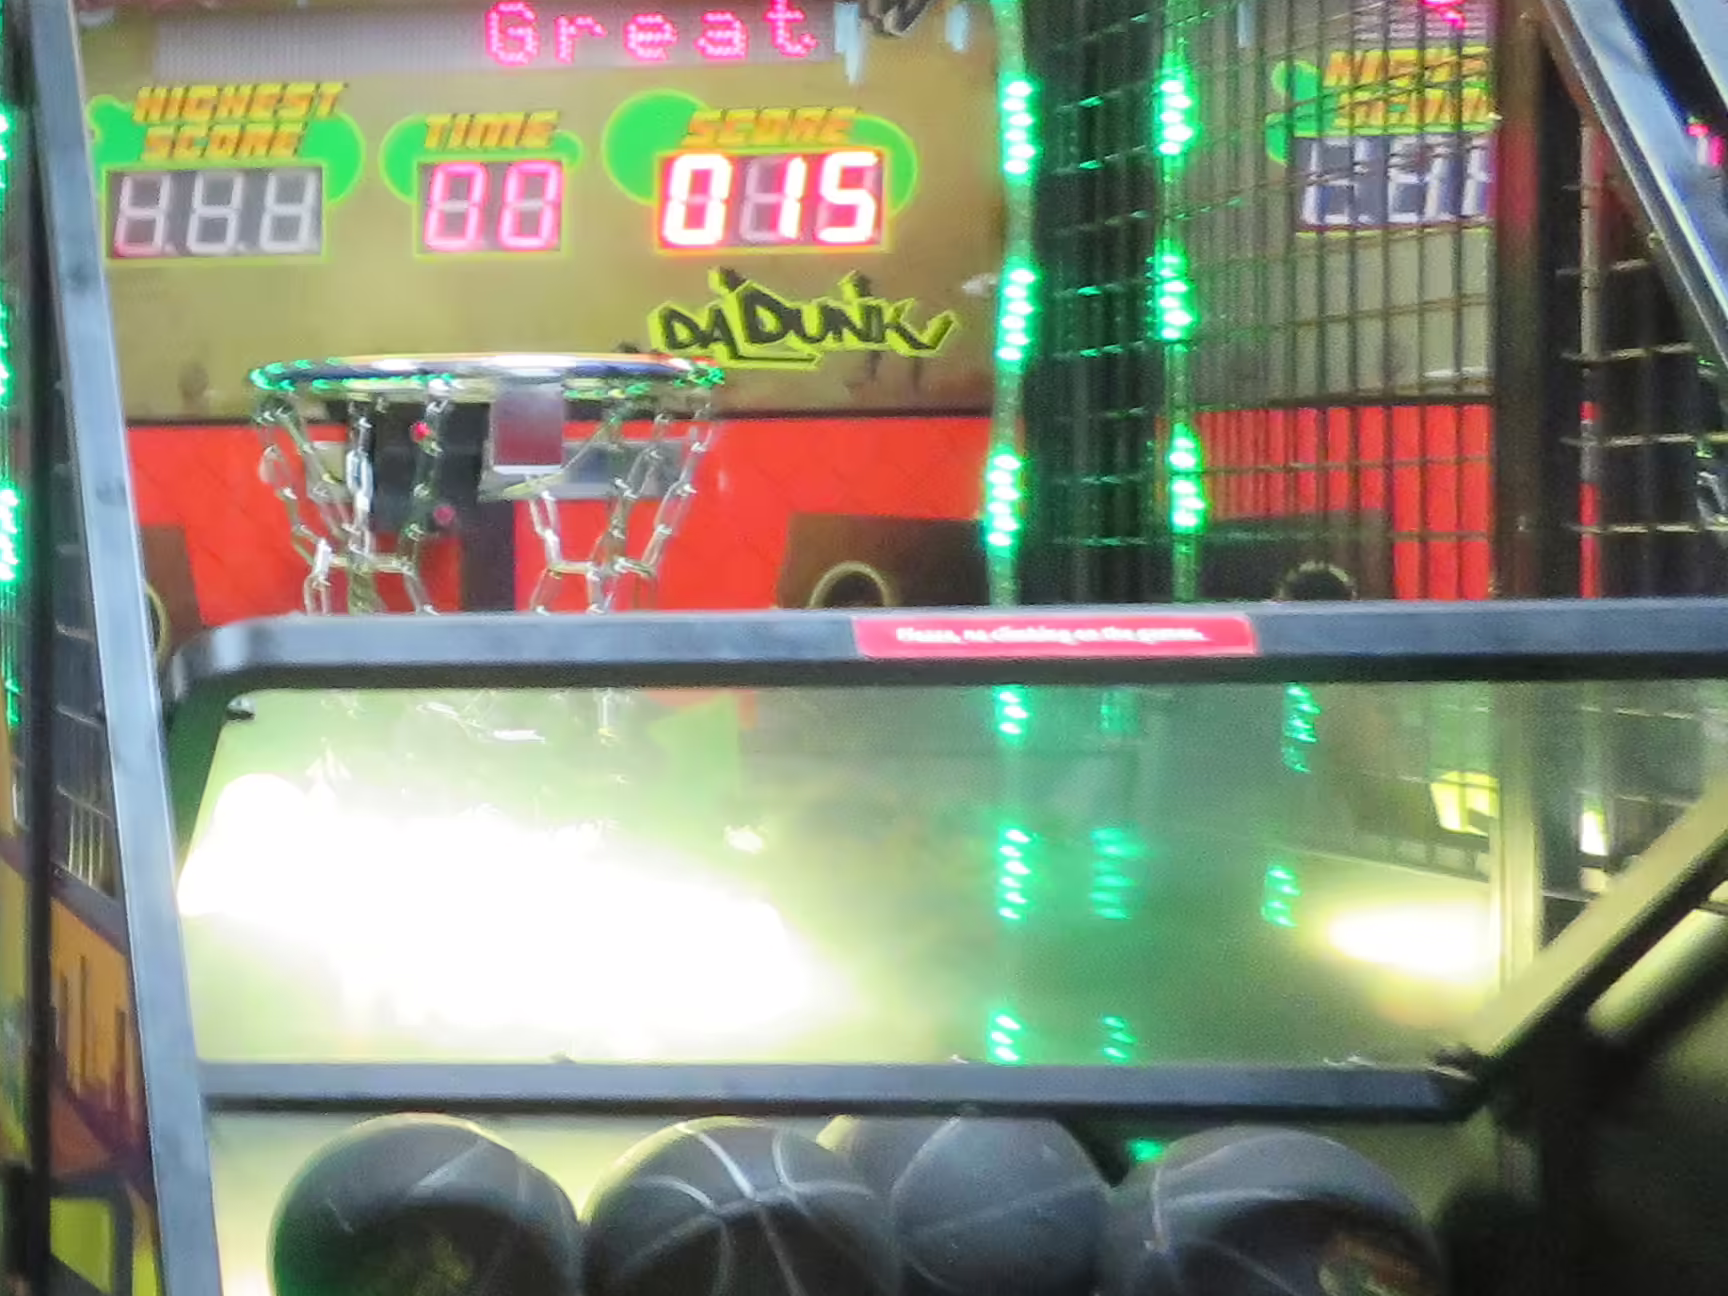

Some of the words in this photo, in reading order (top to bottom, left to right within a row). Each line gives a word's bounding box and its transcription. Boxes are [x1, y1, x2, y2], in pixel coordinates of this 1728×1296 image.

[132, 82, 348, 124] HIGHEST
[141, 121, 306, 162] SCORE
[424, 111, 560, 150] TIME
[680, 106, 862, 147] SCORE
[661, 149, 880, 248] 015
